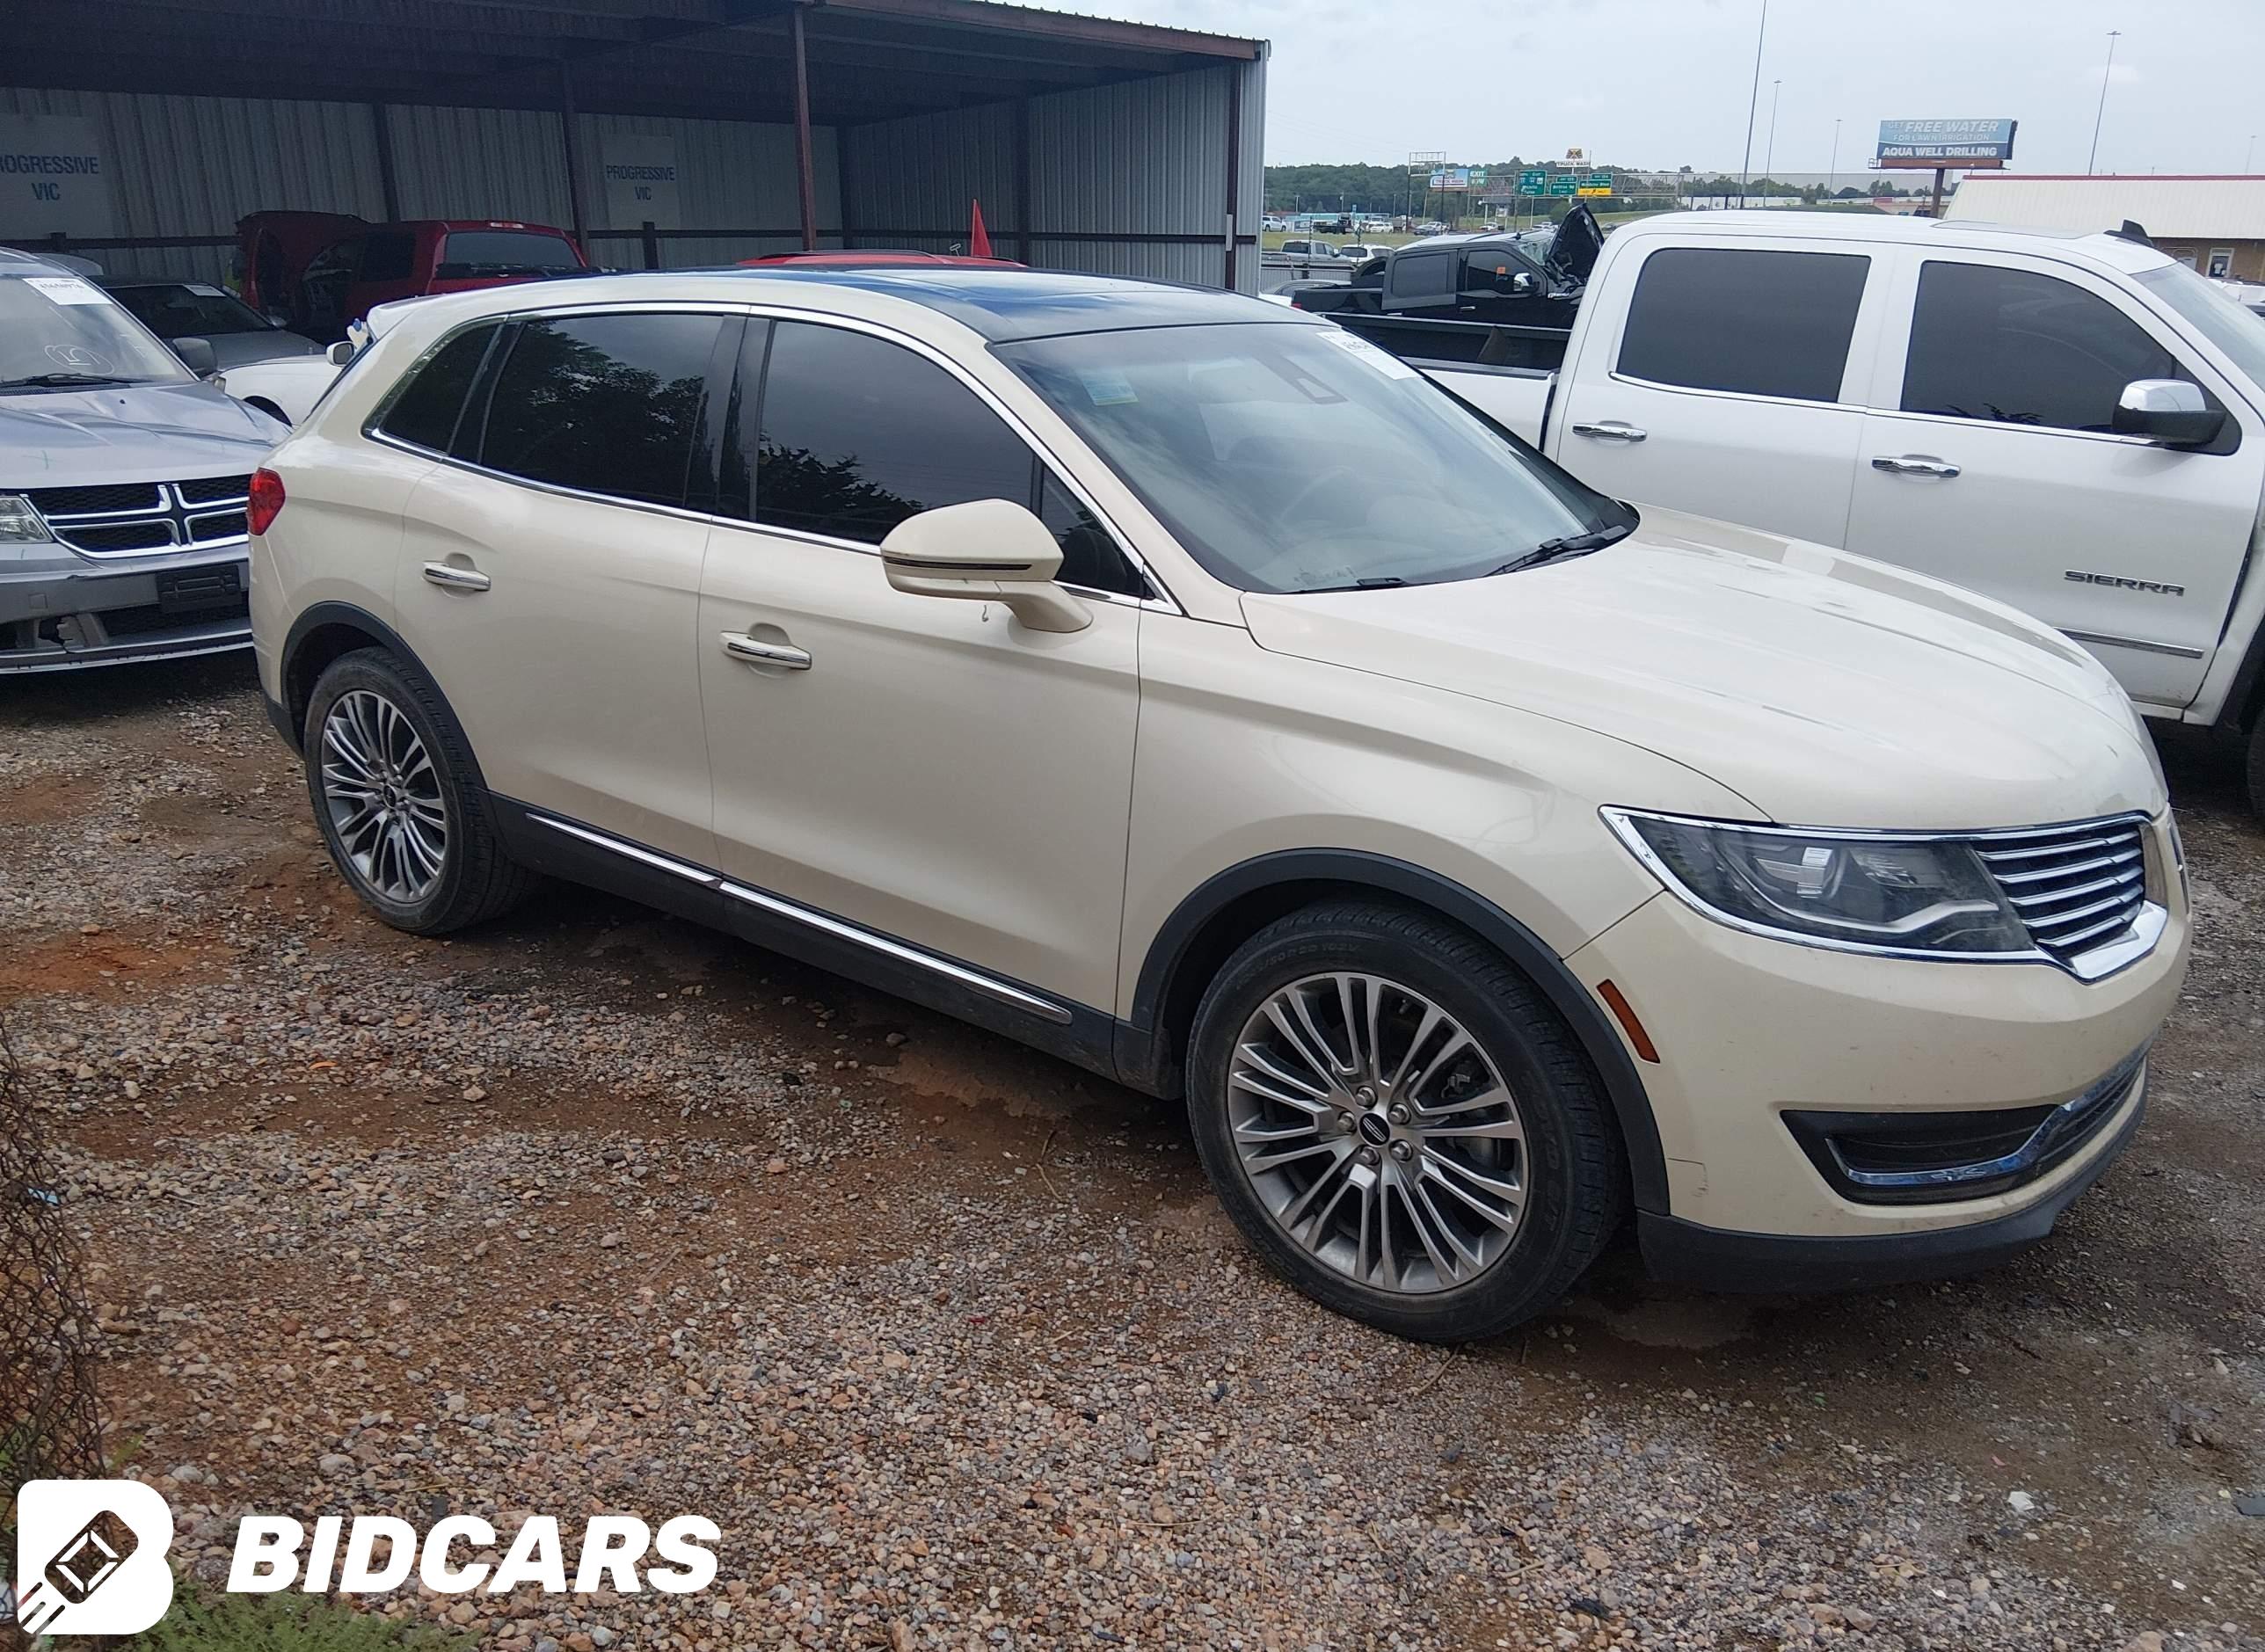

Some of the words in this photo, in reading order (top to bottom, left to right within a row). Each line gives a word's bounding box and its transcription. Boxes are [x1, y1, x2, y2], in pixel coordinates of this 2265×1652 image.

[1904, 121, 1943, 133] FREE
[1946, 120, 1999, 133] WATER
[1883, 147, 1913, 156] AQUA
[1915, 147, 1943, 156] WELL
[1945, 147, 1998, 156] DRILLING
[605, 164, 675, 181] PROGRESSIVE
[31, 182, 61, 200] VIC
[634, 186, 652, 200] VIC
[2064, 569, 2186, 598] SIERRA
